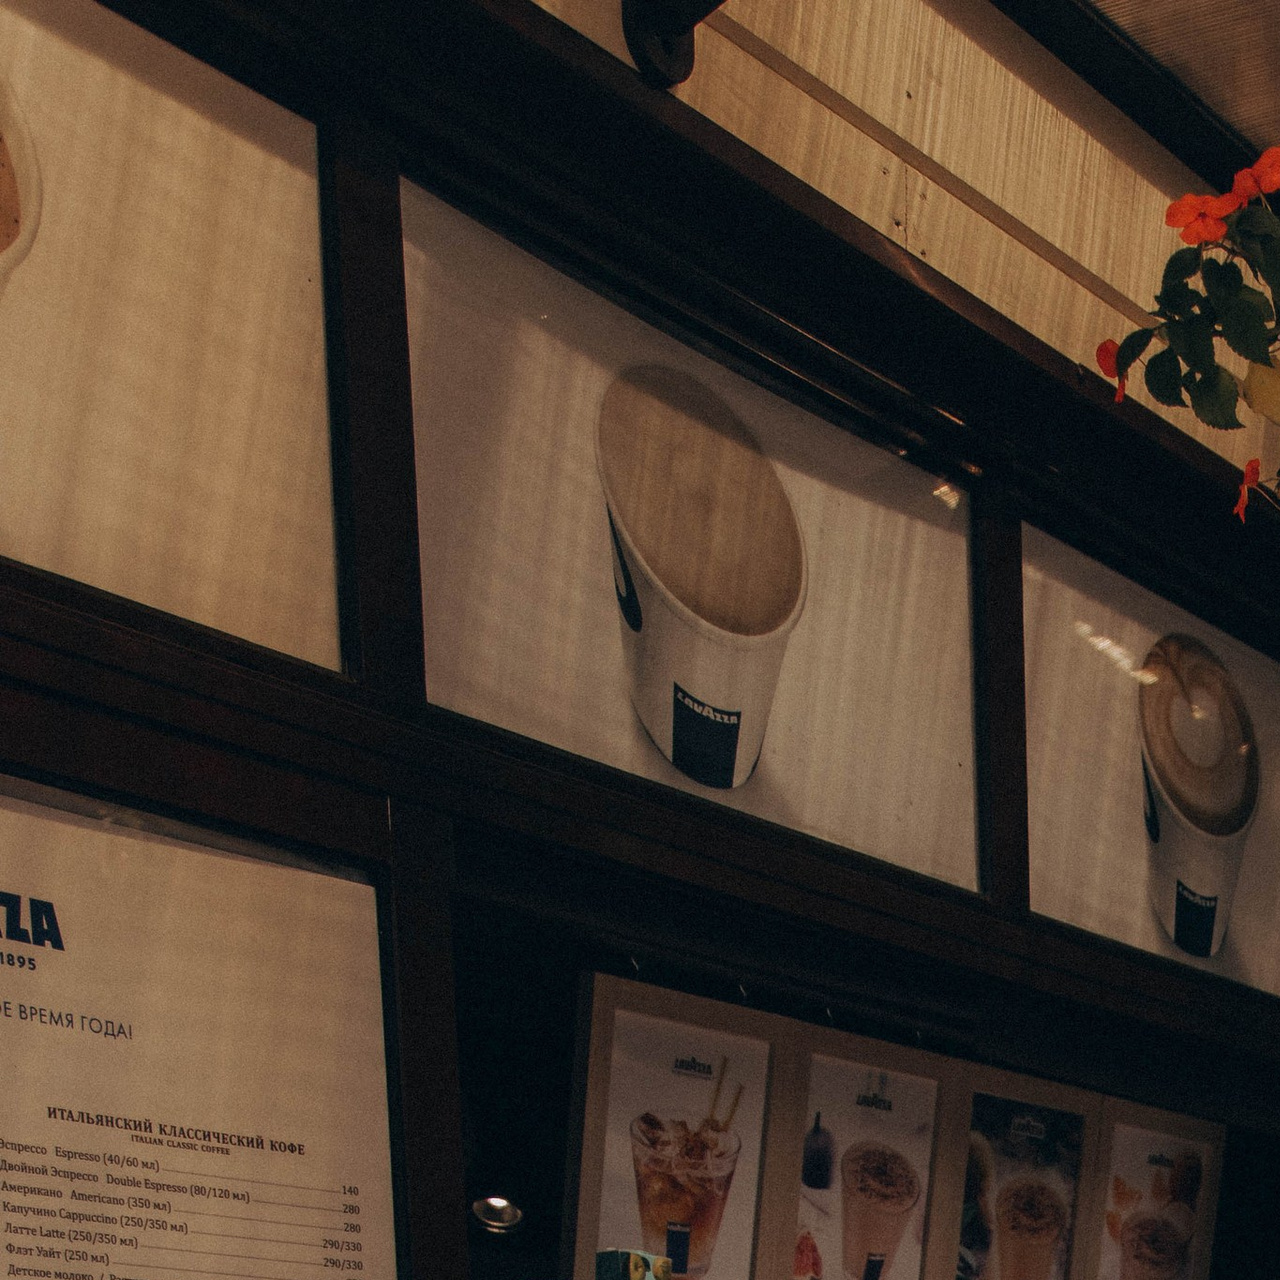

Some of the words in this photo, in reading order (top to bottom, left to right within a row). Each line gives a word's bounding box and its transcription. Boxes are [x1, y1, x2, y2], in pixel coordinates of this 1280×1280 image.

[677, 691, 738, 724] LAVAZZA
[19, 1004, 74, 1029] ВРЕМЯ
[80, 1015, 132, 1040] ГОДА!
[47, 1106, 153, 1134] ИТАЛЬЯНСКИЙ
[159, 1124, 264, 1149] КЛАССИЧЕСКИЙ
[270, 1140, 305, 1155] КОФЕ
[131, 1134, 163, 1145] ITALIAN
[167, 1139, 198, 1151] CLASSIC
[201, 1144, 230, 1155] COFFEE
[0, 1160, 48, 1176] Двойной
[51, 1166, 98, 1183] Эспрессо
[106, 1174, 141, 1188] Double
[144, 1179, 187, 1196] Espresso
[190, 1184, 230, 1200] (80/120
[232, 1191, 250, 1204] мл)
[343, 1204, 360, 1214] 280
[55, 1146, 100, 1164] Espresso
[103, 1153, 139, 1168] (40/60
[141, 1160, 160, 1172] мл)
[342, 1185, 359, 1196] 140
[1, 1181, 62, 1198] Американо
[70, 1189, 125, 1206] Americano
[127, 1197, 151, 1209] (350
[152, 1201, 172, 1214] мл)
[344, 1223, 361, 1233] 280
[2, 1202, 57, 1218] Капучино
[59, 1208, 117, 1225] Cappuccino
[120, 1216, 168, 1231] (250/350
[170, 1222, 188, 1234] мл)
[323, 1239, 362, 1252] 290/330
[7, 1264, 52, 1278] Детское
